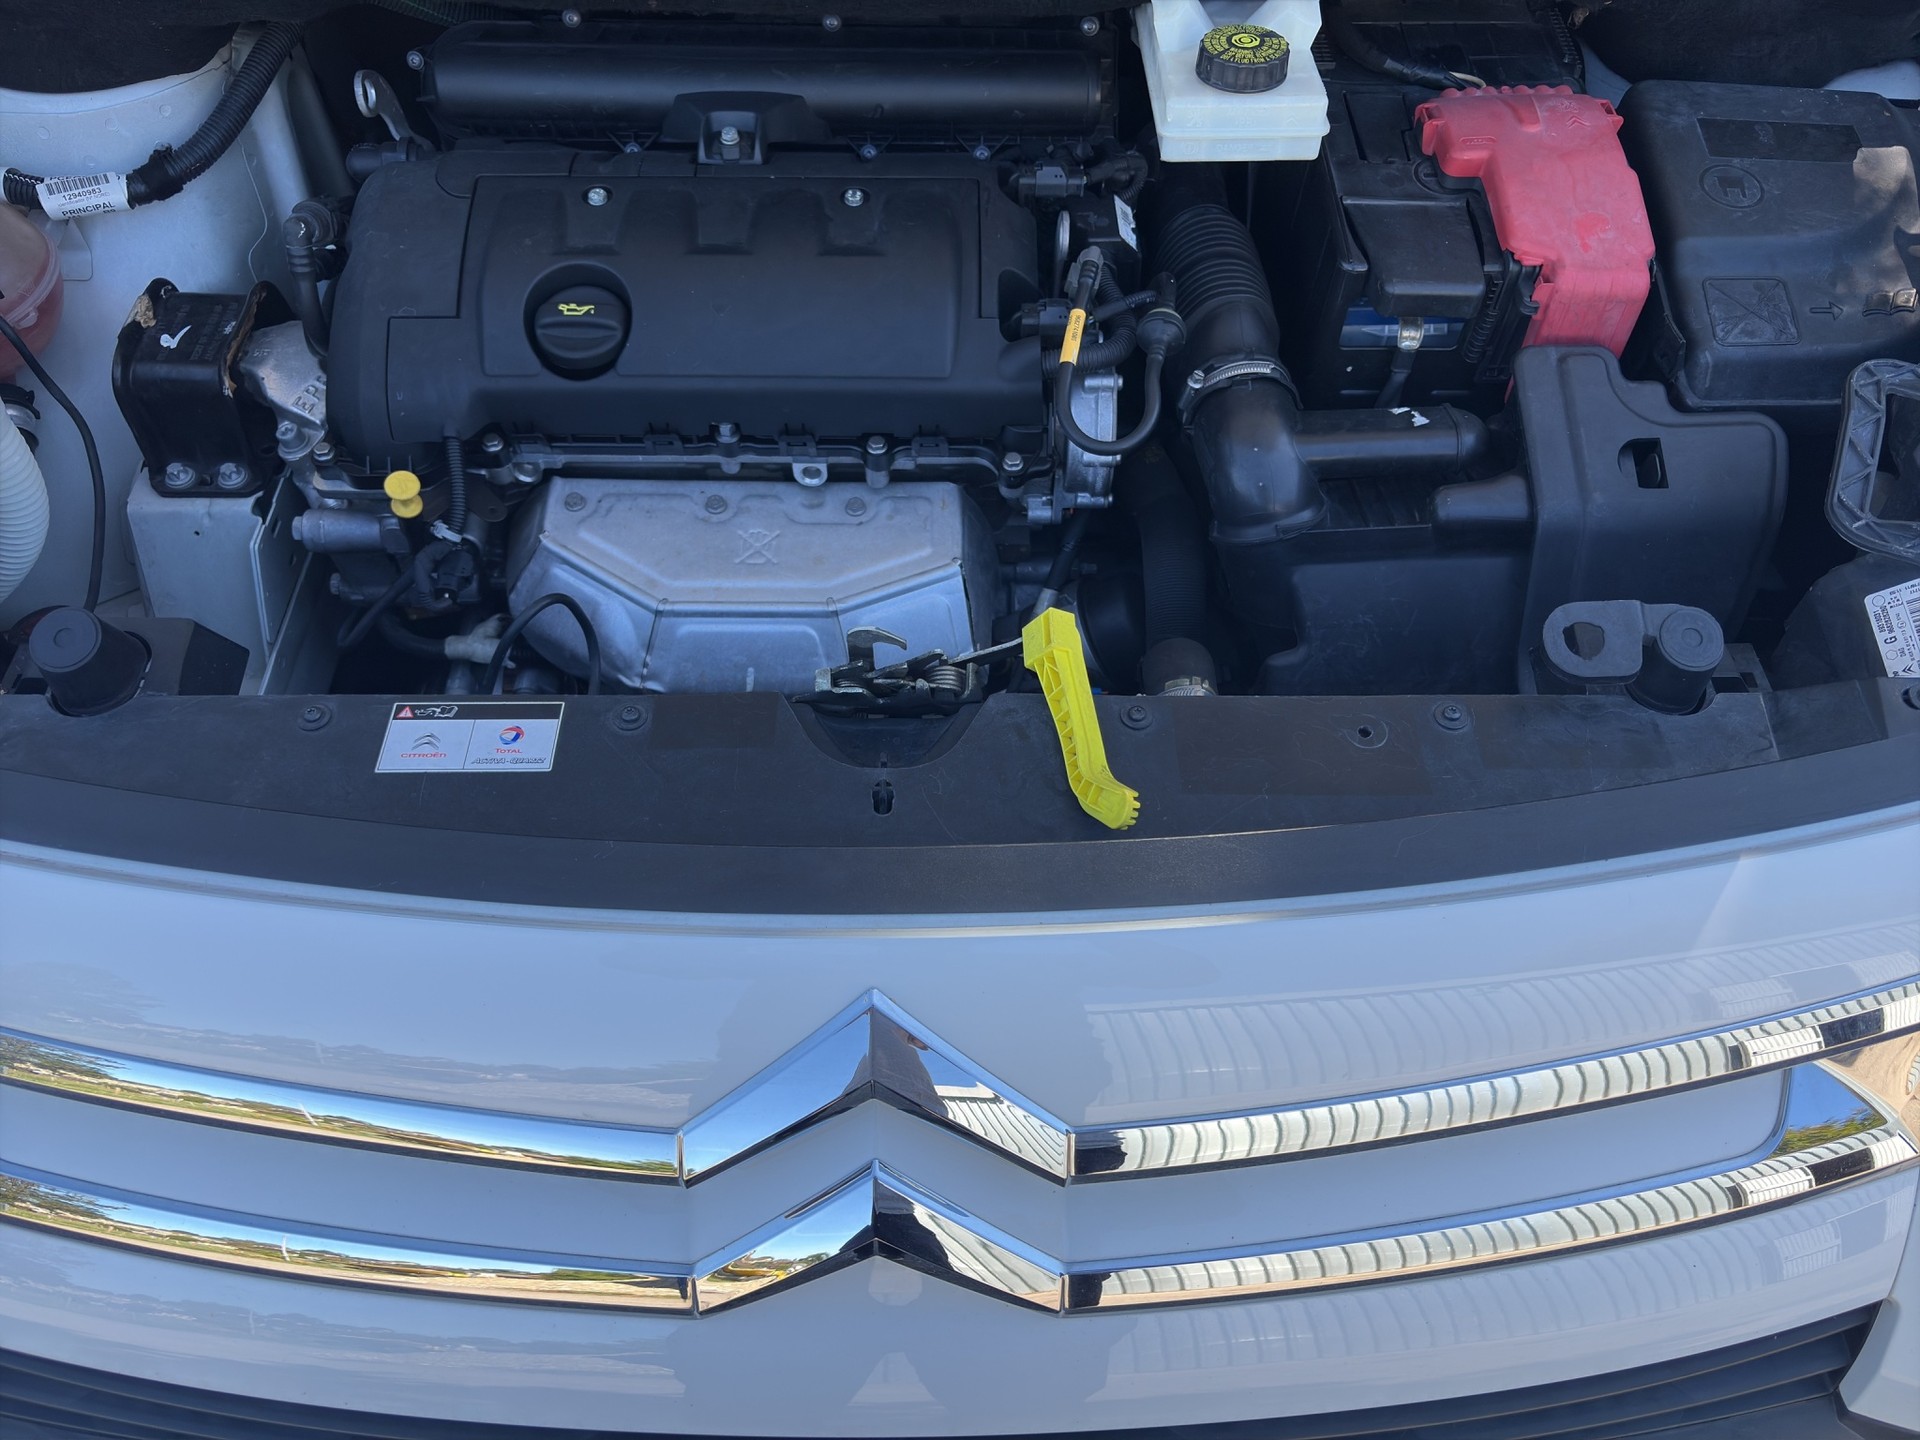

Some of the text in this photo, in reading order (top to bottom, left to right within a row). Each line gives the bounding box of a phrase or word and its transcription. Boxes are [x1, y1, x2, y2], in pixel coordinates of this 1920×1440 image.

[63, 187, 102, 201] 12940983
[61, 201, 116, 217] PRINCIPAL
[1884, 636, 1897, 644] G
